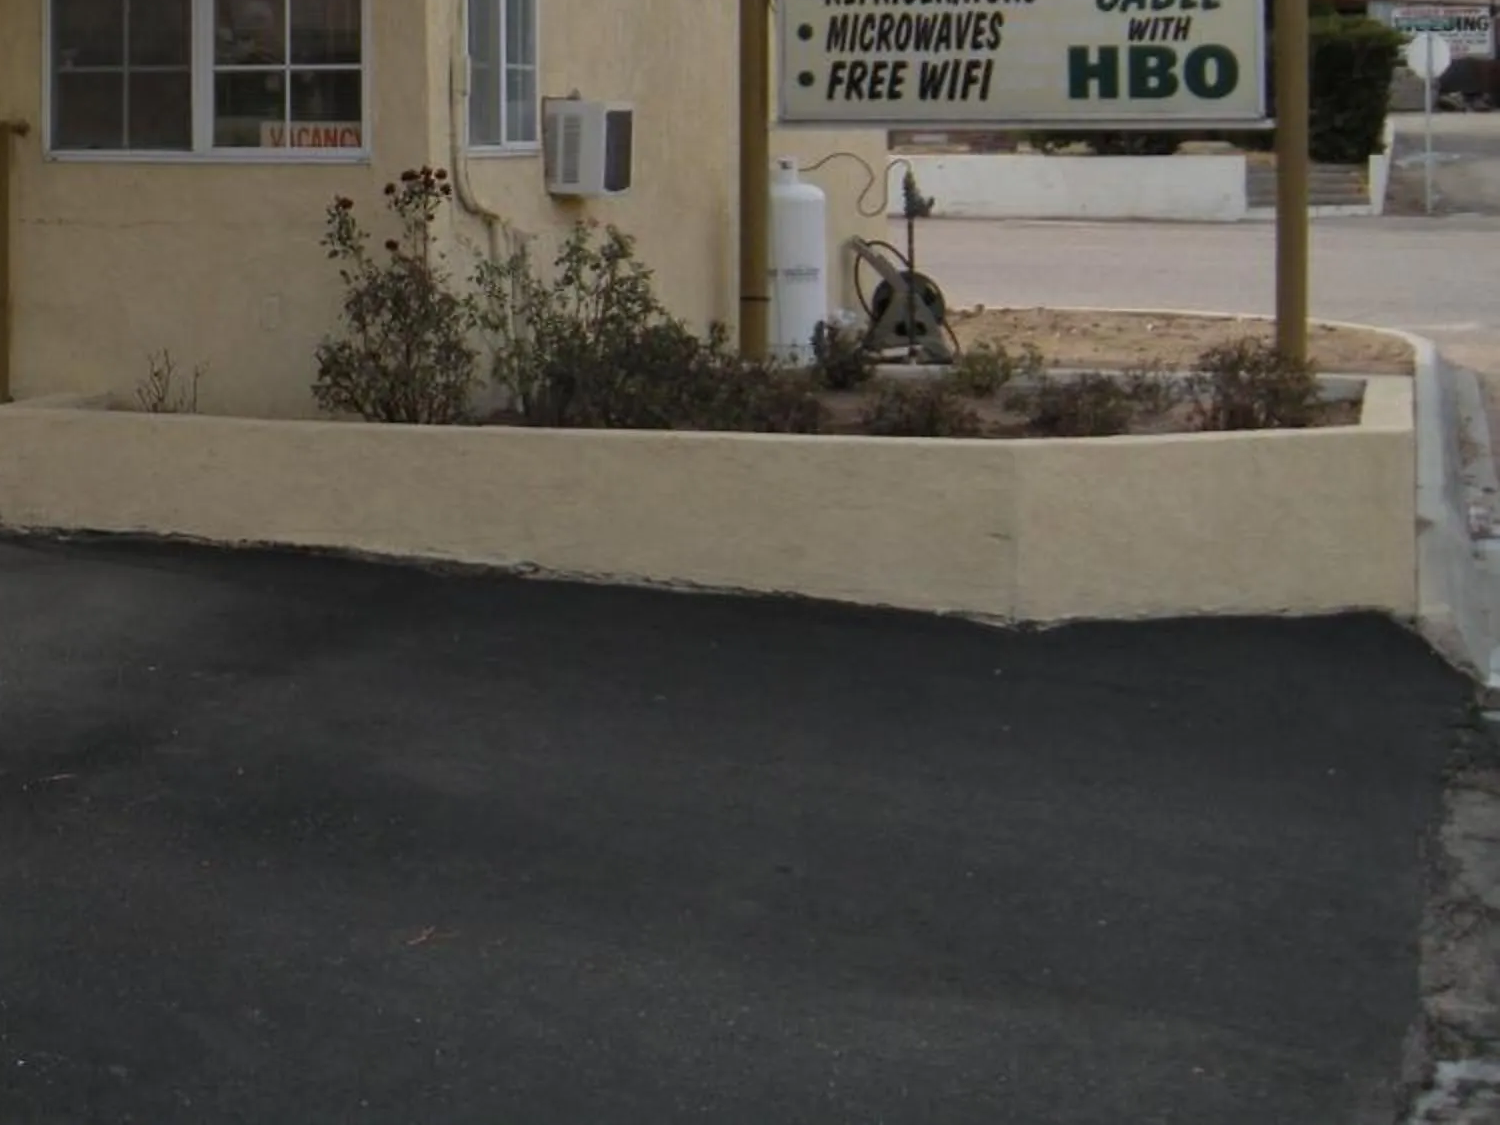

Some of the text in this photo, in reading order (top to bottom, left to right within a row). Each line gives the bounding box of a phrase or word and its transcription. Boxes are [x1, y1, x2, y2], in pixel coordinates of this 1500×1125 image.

[825, 10, 1005, 53] MICROWAVES
[1127, 16, 1192, 41] WITH
[826, 58, 995, 102] FREE WIFI
[1068, 44, 1239, 100] HBO
